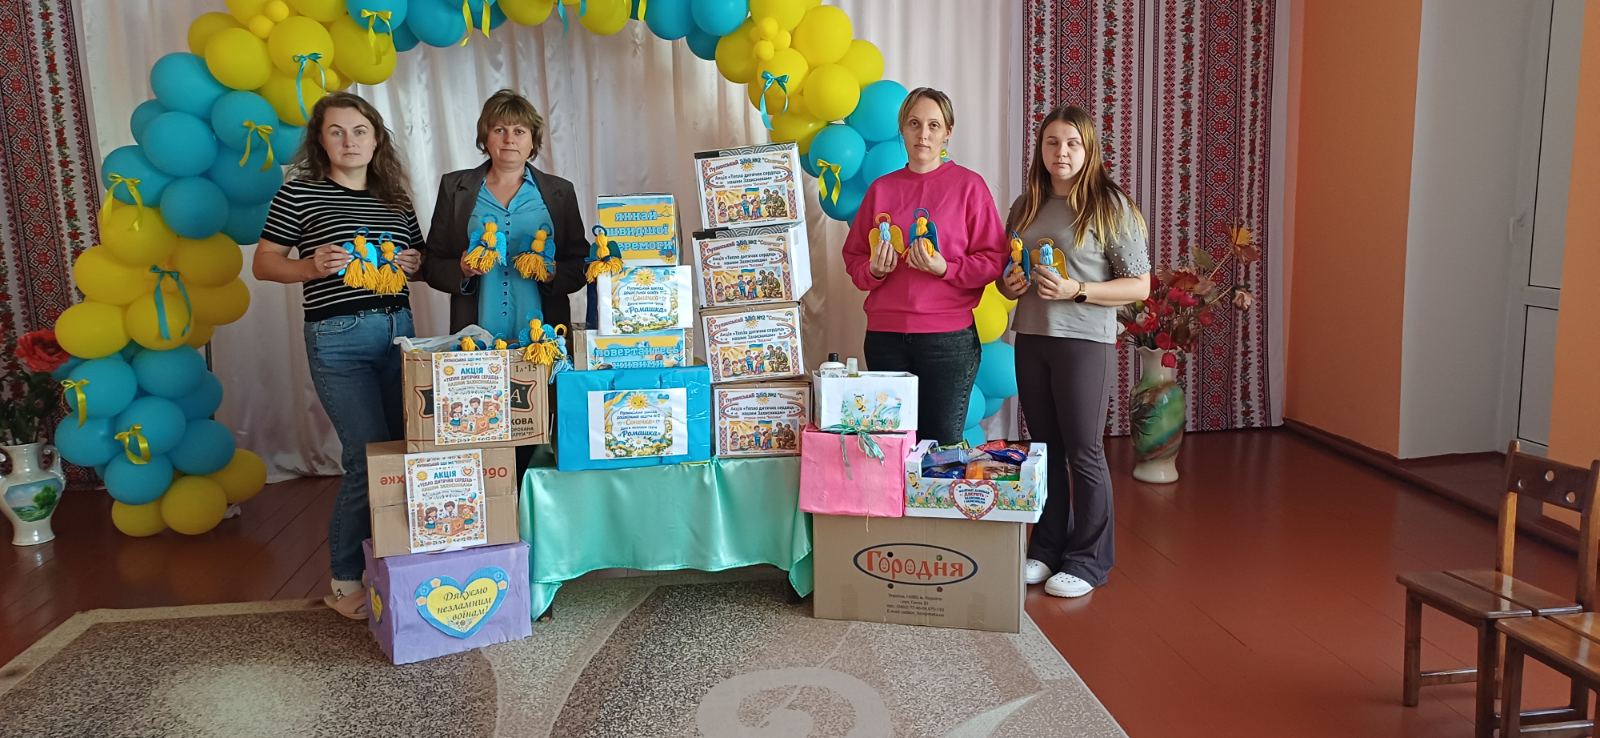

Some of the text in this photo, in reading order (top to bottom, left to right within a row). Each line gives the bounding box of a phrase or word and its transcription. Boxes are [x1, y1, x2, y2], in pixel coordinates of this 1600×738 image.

[617, 241, 674, 251] еремоги
[461, 367, 484, 375] АКЦІЯ
[433, 470, 457, 479] АКЦІЯ
[866, 550, 964, 581] Городня
[443, 586, 488, 602] Дякуємо
[437, 598, 492, 614] незламним
